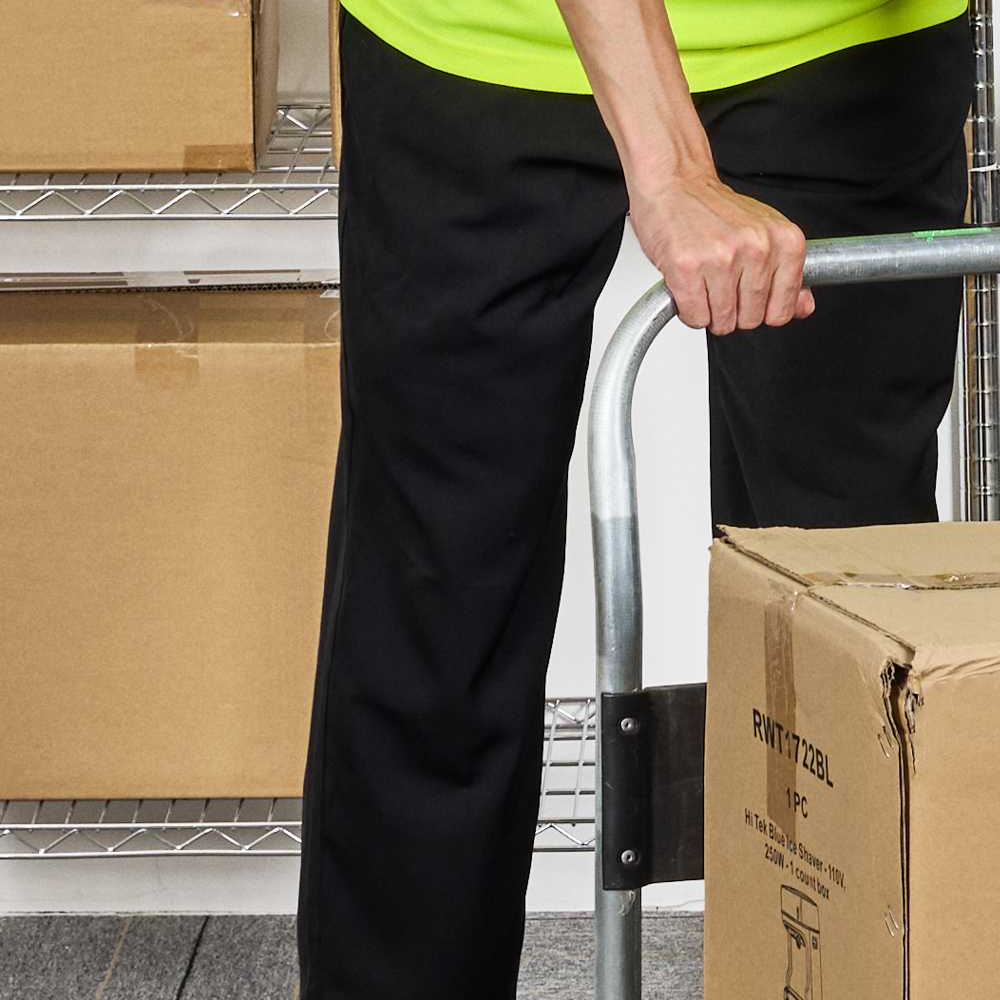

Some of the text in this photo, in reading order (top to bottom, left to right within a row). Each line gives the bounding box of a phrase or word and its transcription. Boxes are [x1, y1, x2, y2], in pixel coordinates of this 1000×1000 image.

[753, 708, 834, 788] RWT1722BL
[786, 787, 808, 819] 1 PC
[744, 808, 753, 827] Hi
[754, 813, 768, 834] Tek
[768, 822, 785, 847] Blue
[798, 842, 823, 872] Shaver
